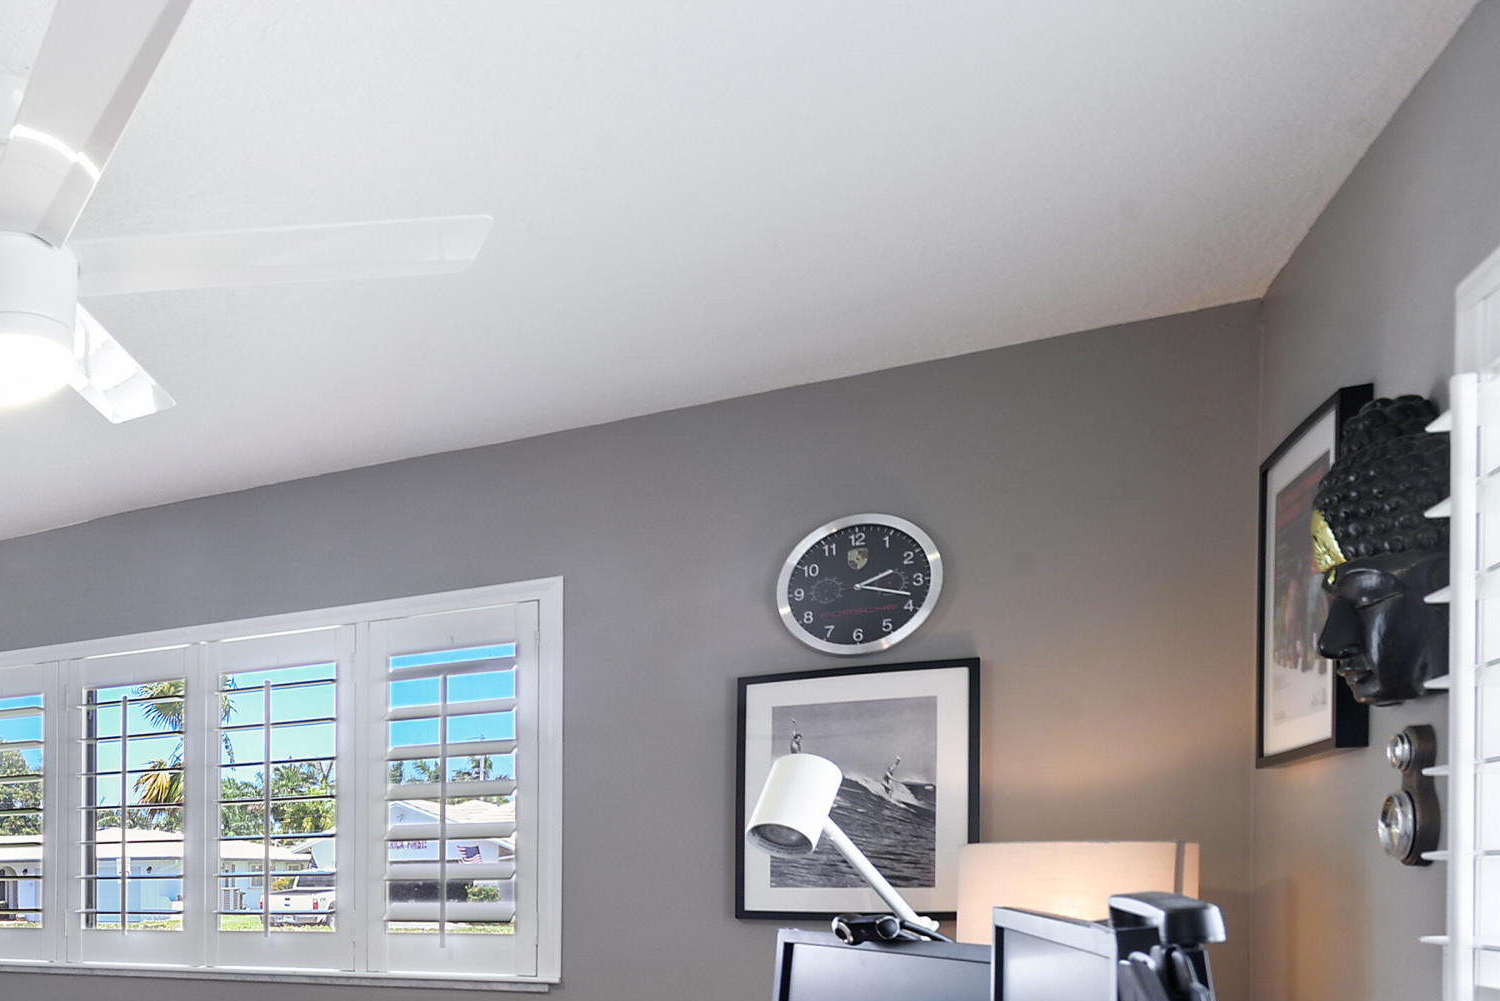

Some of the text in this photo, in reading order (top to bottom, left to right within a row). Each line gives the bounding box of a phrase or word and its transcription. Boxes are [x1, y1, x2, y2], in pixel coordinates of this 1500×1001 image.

[849, 532, 866, 546] 12
[883, 535, 890, 548] 1
[823, 543, 837, 557] 11
[903, 550, 915, 565] 2
[803, 563, 820, 578] 10
[912, 571, 924, 586] 3
[794, 588, 805, 601] 9
[903, 600, 915, 612] 4
[803, 610, 814, 624] 8
[824, 625, 835, 638] 7
[882, 618, 893, 633] 5
[852, 628, 864, 642] 6
